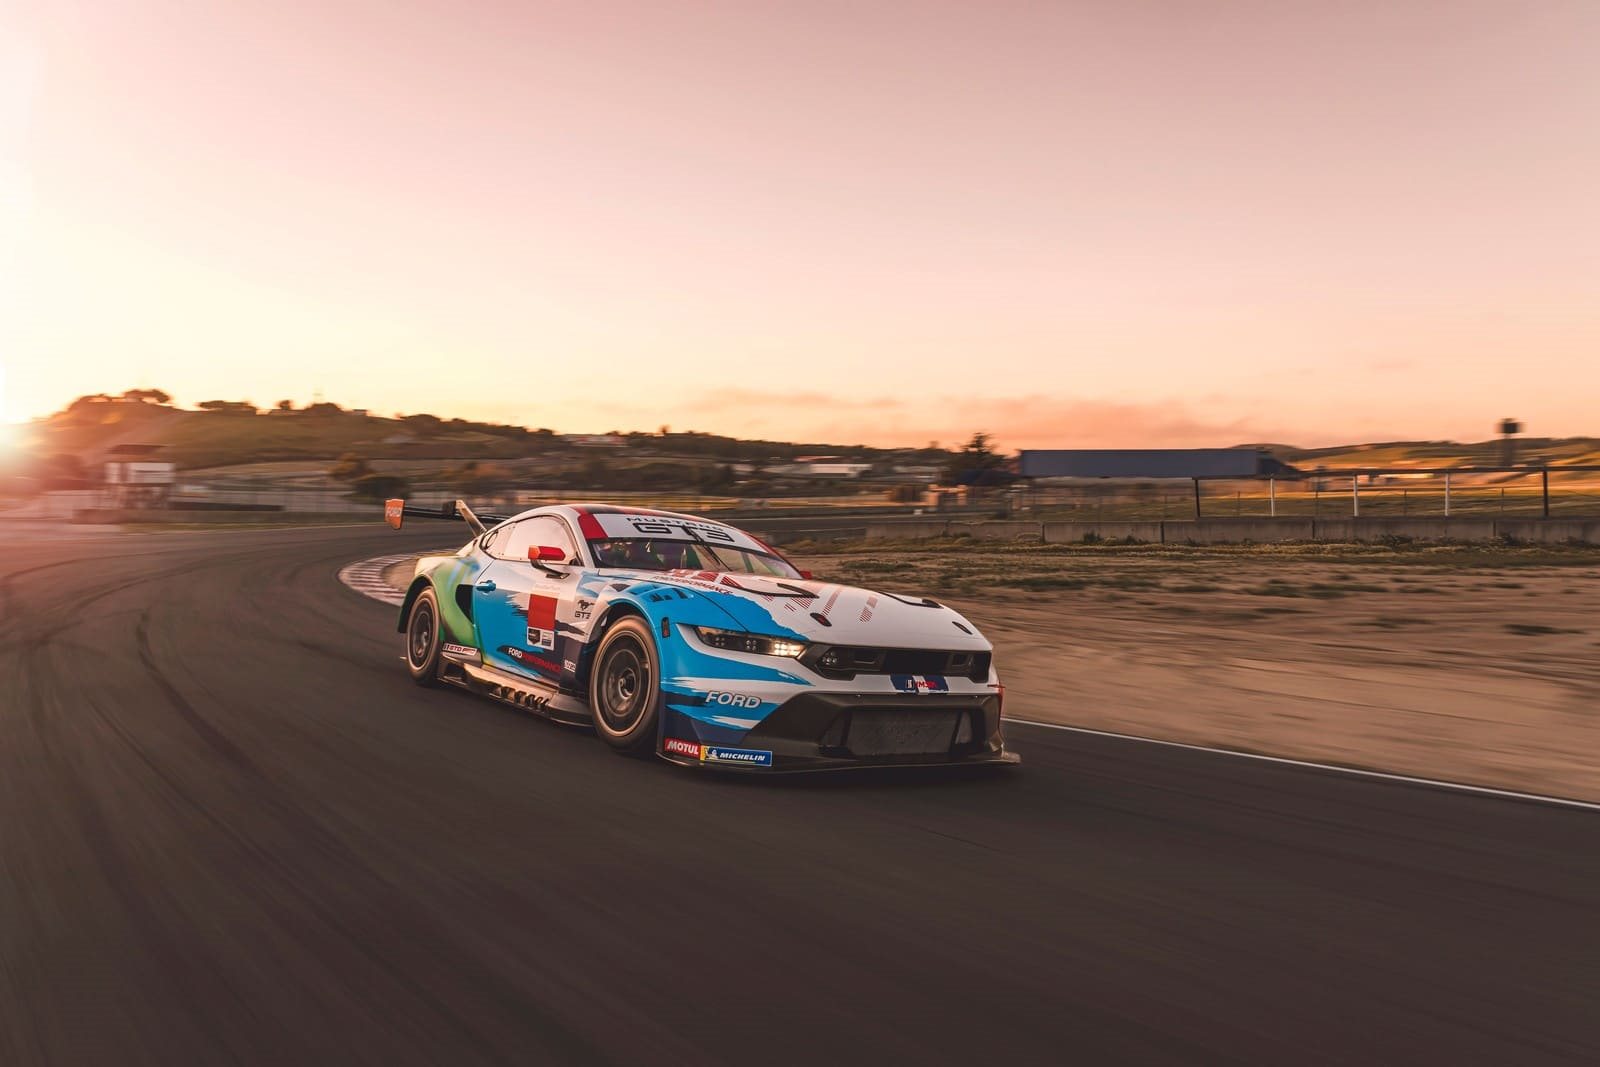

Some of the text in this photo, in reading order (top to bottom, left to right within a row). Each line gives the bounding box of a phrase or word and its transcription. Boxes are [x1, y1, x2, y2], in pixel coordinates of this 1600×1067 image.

[632, 523, 735, 542] GT3
[575, 611, 591, 619] GT3
[508, 647, 523, 659] FORD
[705, 690, 761, 708] FORD
[667, 741, 699, 755] MOTUL
[719, 752, 766, 761] MICHELIN
